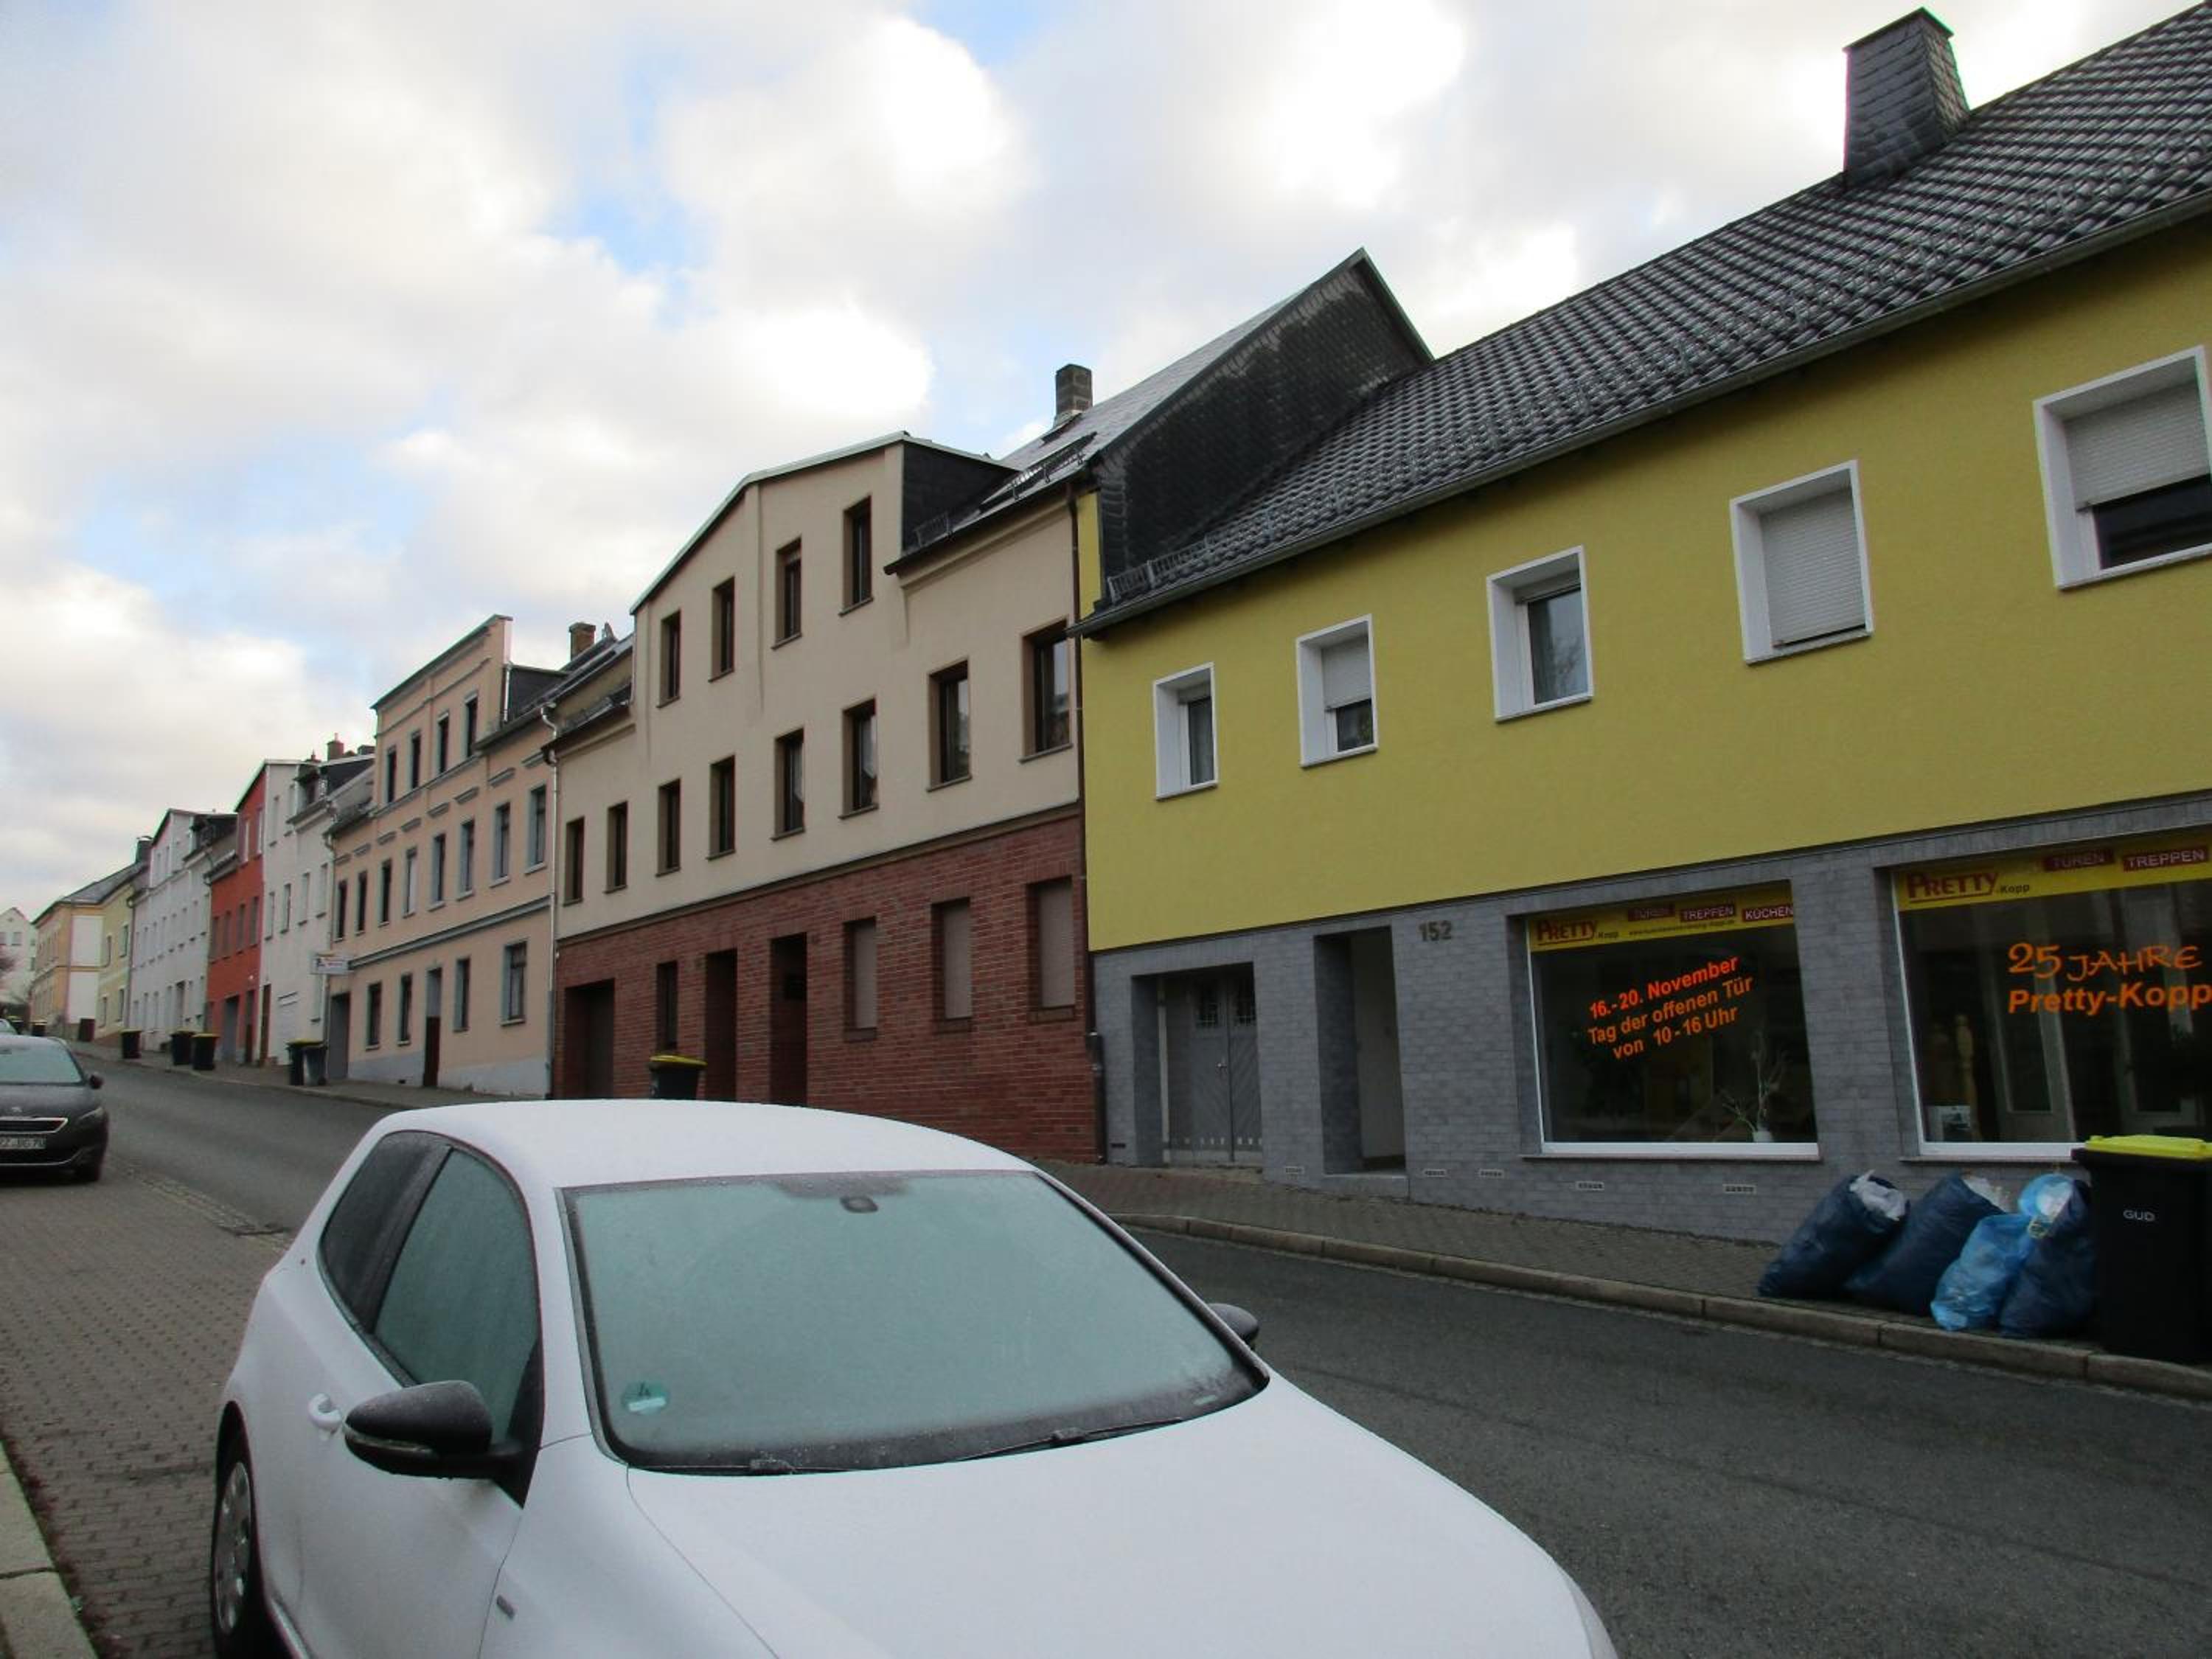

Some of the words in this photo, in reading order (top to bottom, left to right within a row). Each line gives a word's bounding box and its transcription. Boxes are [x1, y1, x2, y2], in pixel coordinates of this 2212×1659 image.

[2126, 849, 2205, 868] TREPPEN
[1906, 872, 2000, 900] PRETTY
[1683, 905, 1733, 921] TREPPEN
[1419, 920, 1453, 942] 152
[1537, 919, 1598, 942] PRETTY
[2008, 942, 2062, 979] 25
[2067, 945, 2202, 981] JAHRE
[1647, 956, 1739, 1001] November
[1587, 1026, 1617, 1045] Tag
[1621, 1013, 1649, 1034] der
[1652, 990, 1719, 1023] offenen
[1722, 977, 1753, 998] Tür
[1613, 1038, 1644, 1060] von
[1705, 1006, 1739, 1029] Uhr
[2123, 1208, 2156, 1222] GUD
